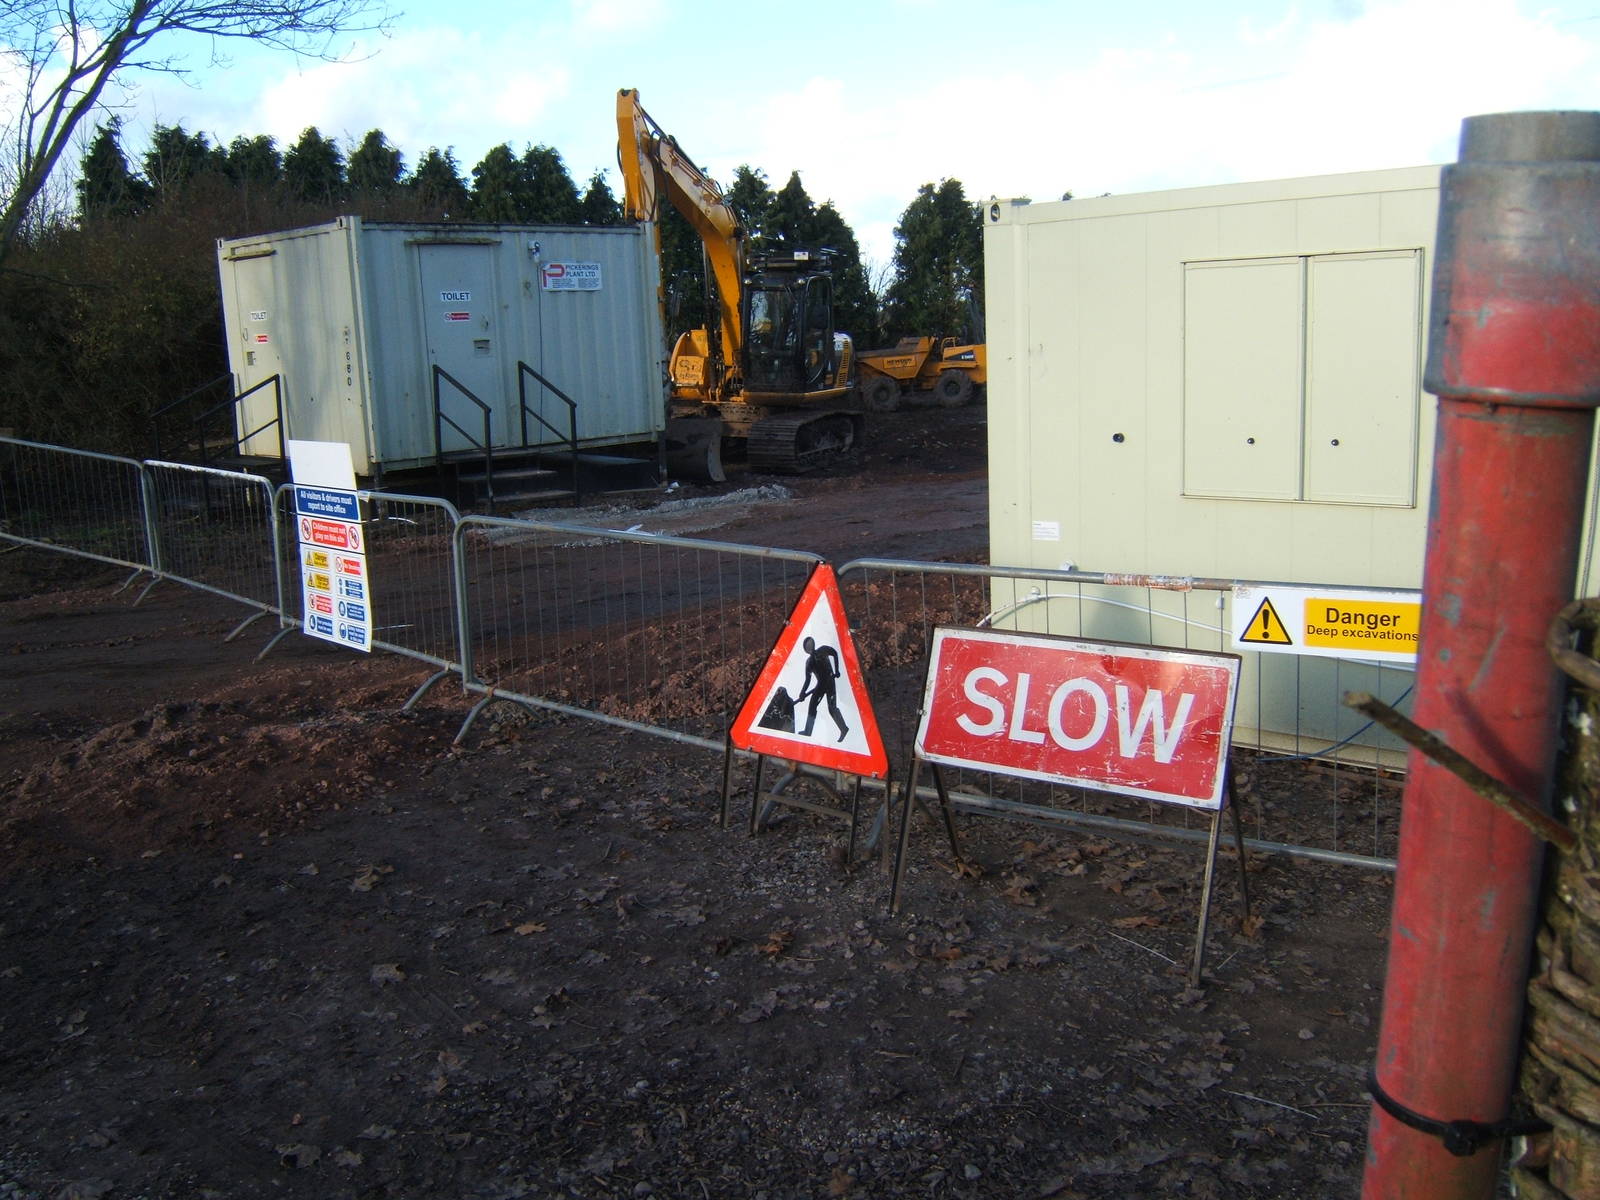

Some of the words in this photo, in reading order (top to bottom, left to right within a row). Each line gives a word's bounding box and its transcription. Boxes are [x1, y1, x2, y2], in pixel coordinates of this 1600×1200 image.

[441, 292, 470, 301] TOILET
[251, 312, 266, 320] TOILET
[307, 491, 321, 501] visitors
[321, 493, 326, 502] &
[326, 494, 341, 504] drivers
[341, 497, 353, 505] must
[308, 502, 321, 511] report
[326, 504, 334, 512] site
[334, 505, 346, 514] office
[312, 522, 328, 532] Children
[328, 525, 338, 533] must
[338, 527, 346, 535] not
[314, 533, 324, 542] play
[330, 534, 338, 542] this
[337, 536, 345, 544] site
[1326, 607, 1401, 630] Danger
[1307, 625, 1339, 638] Deep
[1342, 629, 1419, 642] excavations
[955, 666, 1196, 764] SLOW
